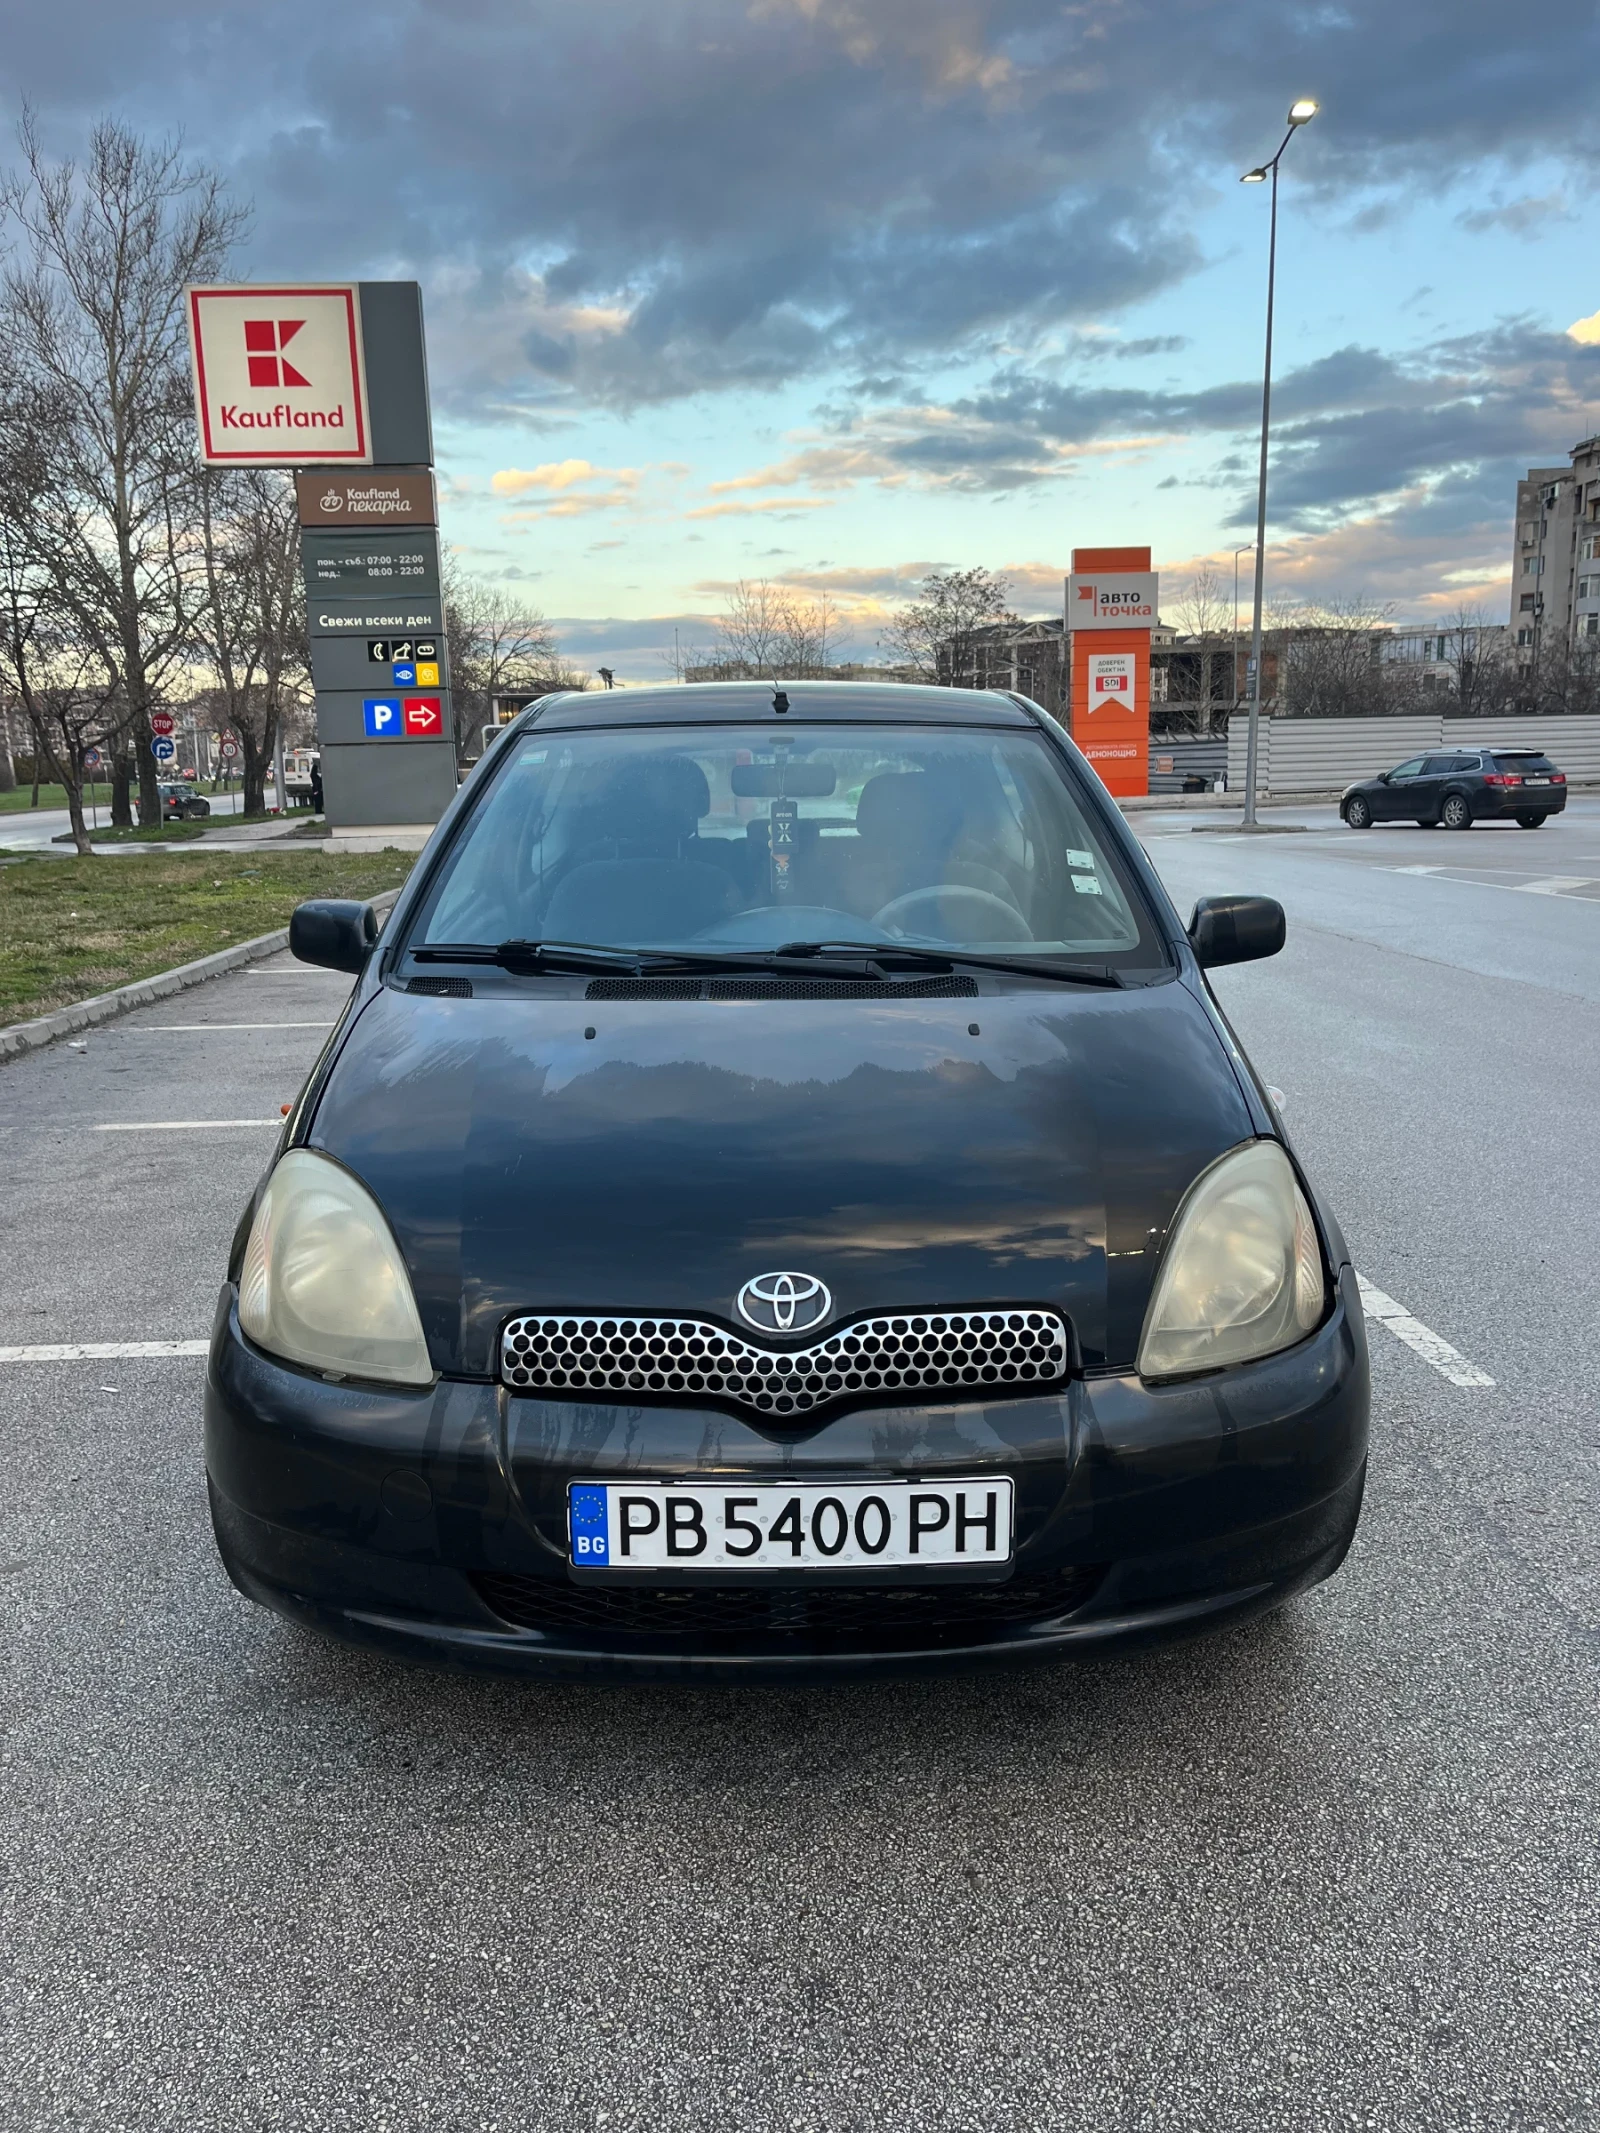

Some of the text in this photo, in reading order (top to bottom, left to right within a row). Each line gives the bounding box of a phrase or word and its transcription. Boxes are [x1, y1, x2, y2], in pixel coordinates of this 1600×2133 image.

[221, 404, 344, 428] Kaufland
[347, 488, 400, 499] Kaufland
[347, 500, 412, 514] пекарна
[345, 557, 366, 566] съб.:
[367, 556, 391, 565] 07:00
[399, 555, 423, 564] 22:00
[368, 567, 392, 576] 08:00
[400, 566, 424, 575] 22:00
[1100, 592, 1140, 604] авто
[1100, 605, 1152, 617] точка
[319, 614, 431, 627] Свежи всеки ден
[1104, 679, 1119, 687] SDI
[374, 705, 392, 730] P
[153, 719, 172, 729] STOP
[226, 743, 234, 753] 30
[1086, 749, 1137, 759] ДЕНОНОЩНО
[618, 1491, 998, 1557] PB 5400 PH
[577, 1536, 606, 1555] BG
